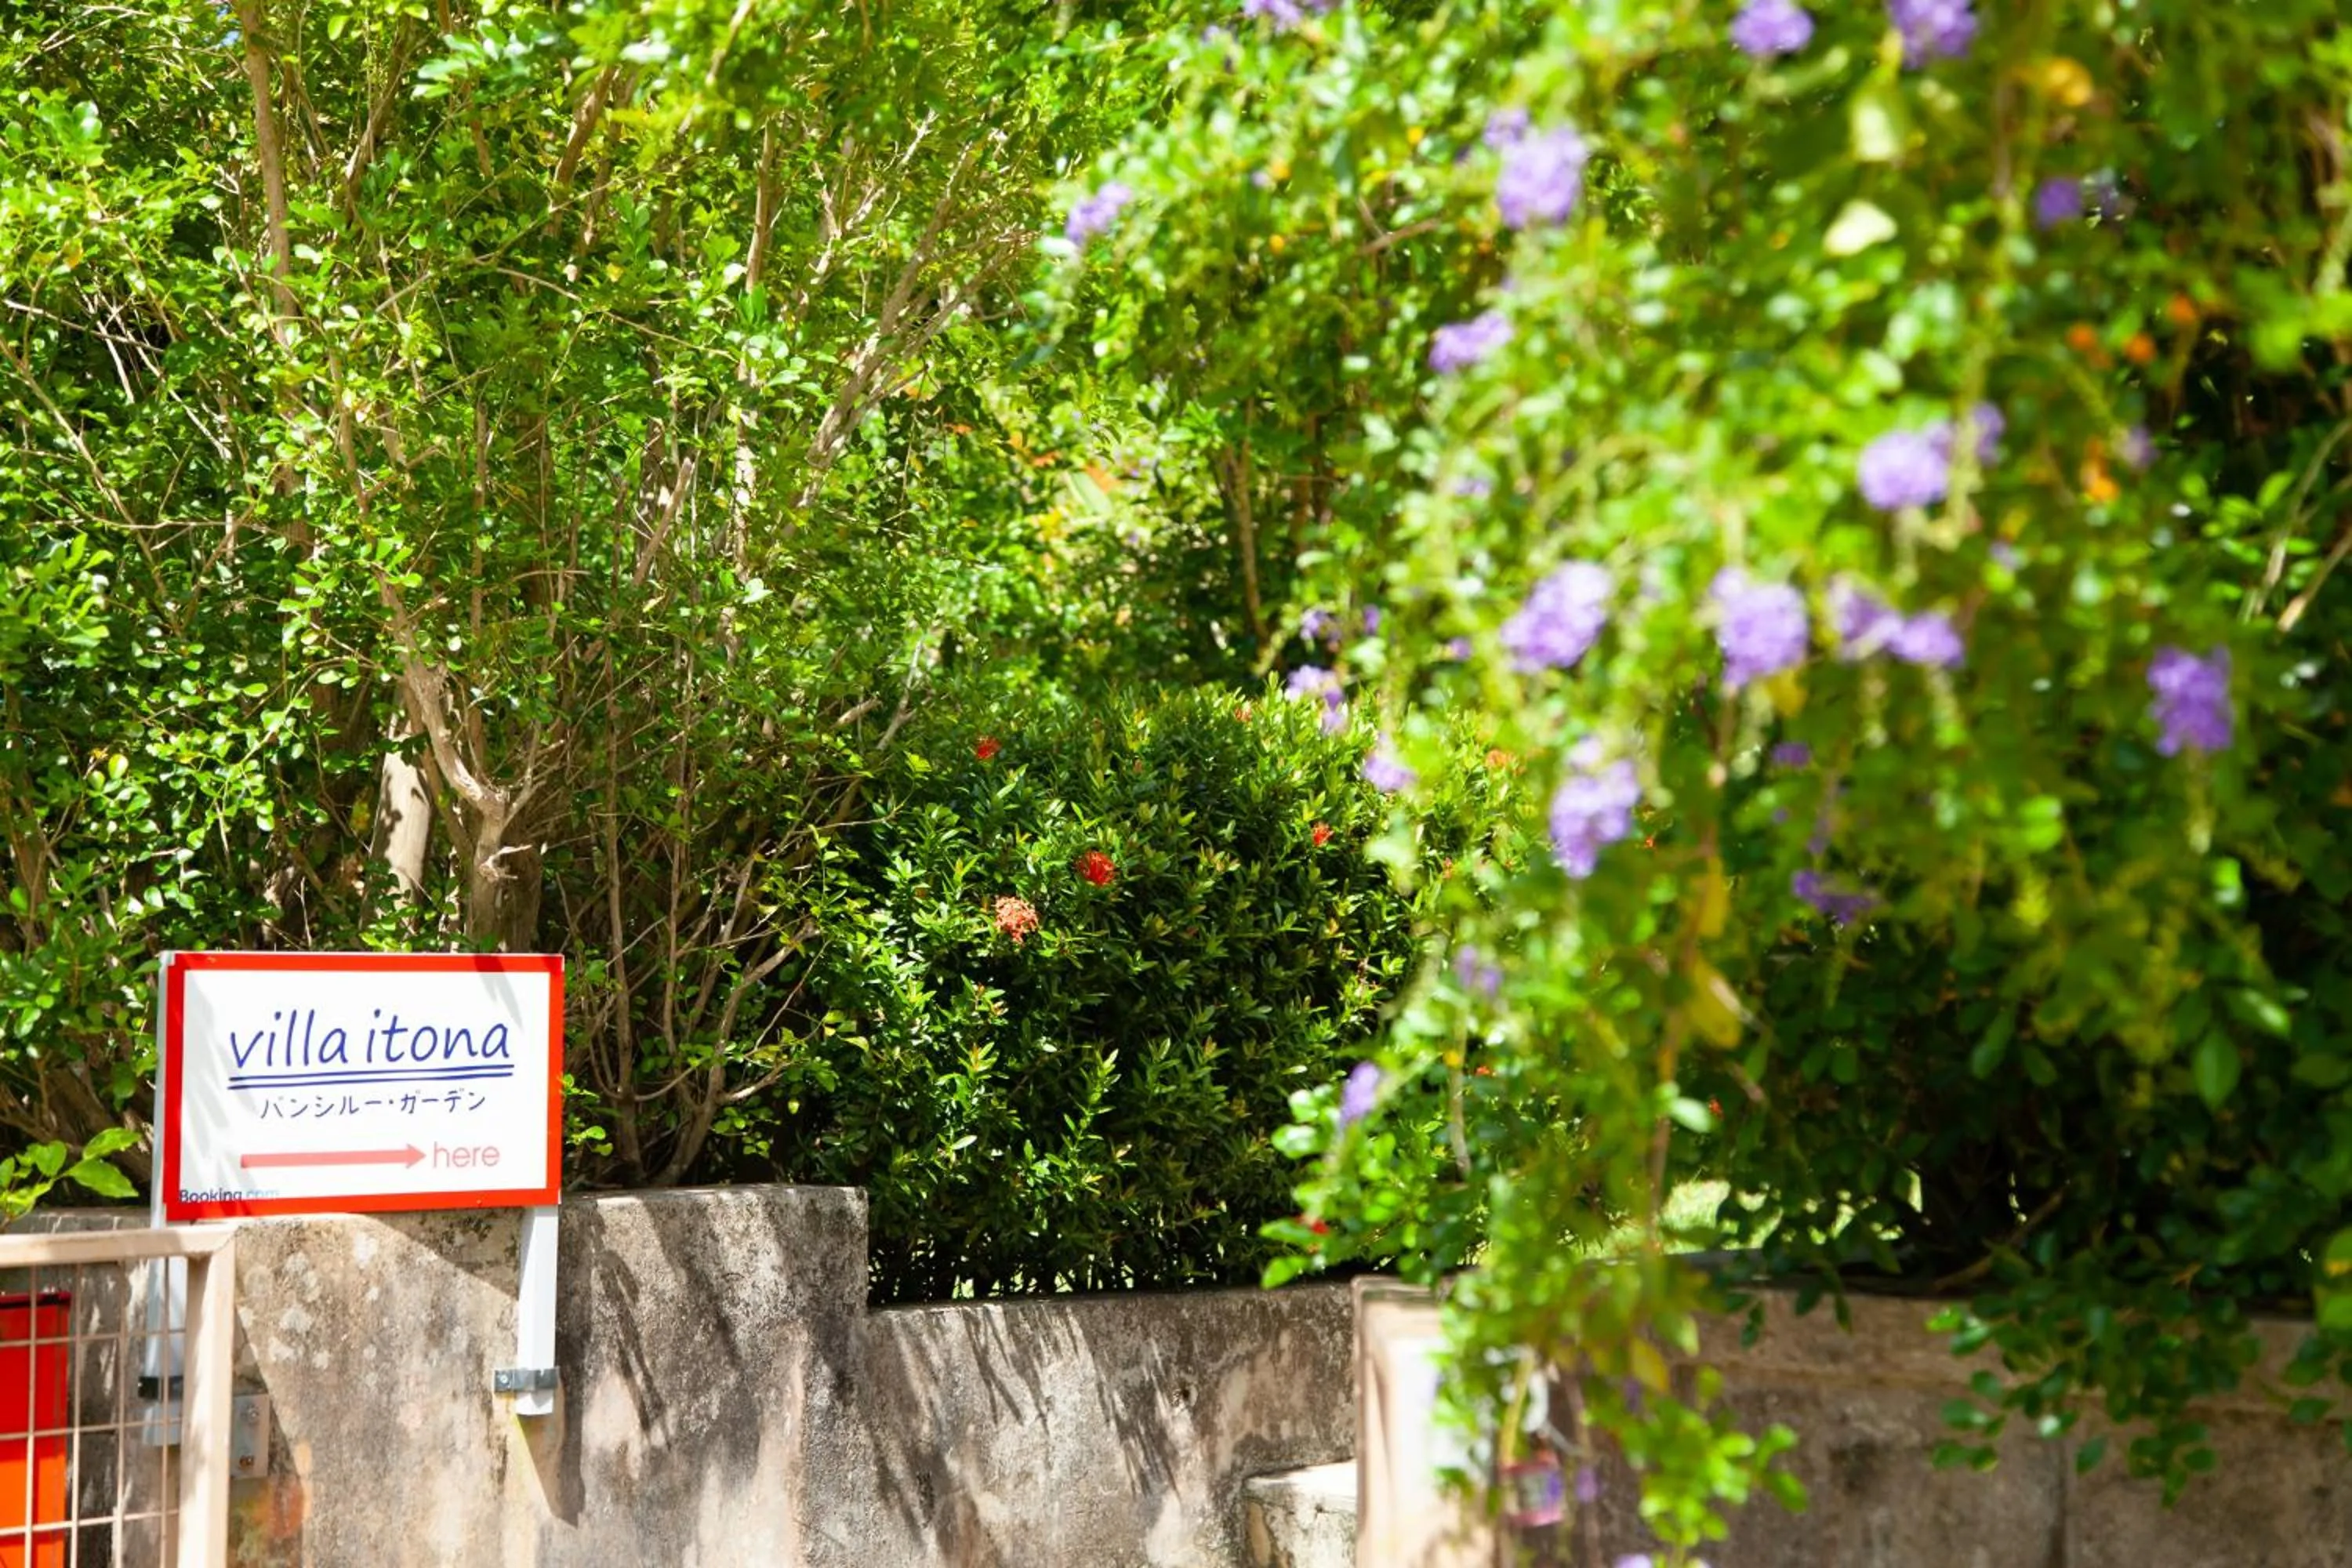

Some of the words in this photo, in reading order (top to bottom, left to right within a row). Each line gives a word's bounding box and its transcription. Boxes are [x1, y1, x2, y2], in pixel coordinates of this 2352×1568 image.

[230, 1009, 348, 1068] villa
[366, 1009, 510, 1063] itona
[433, 1142, 500, 1168] here
[180, 1188, 279, 1202] Bookingcom
